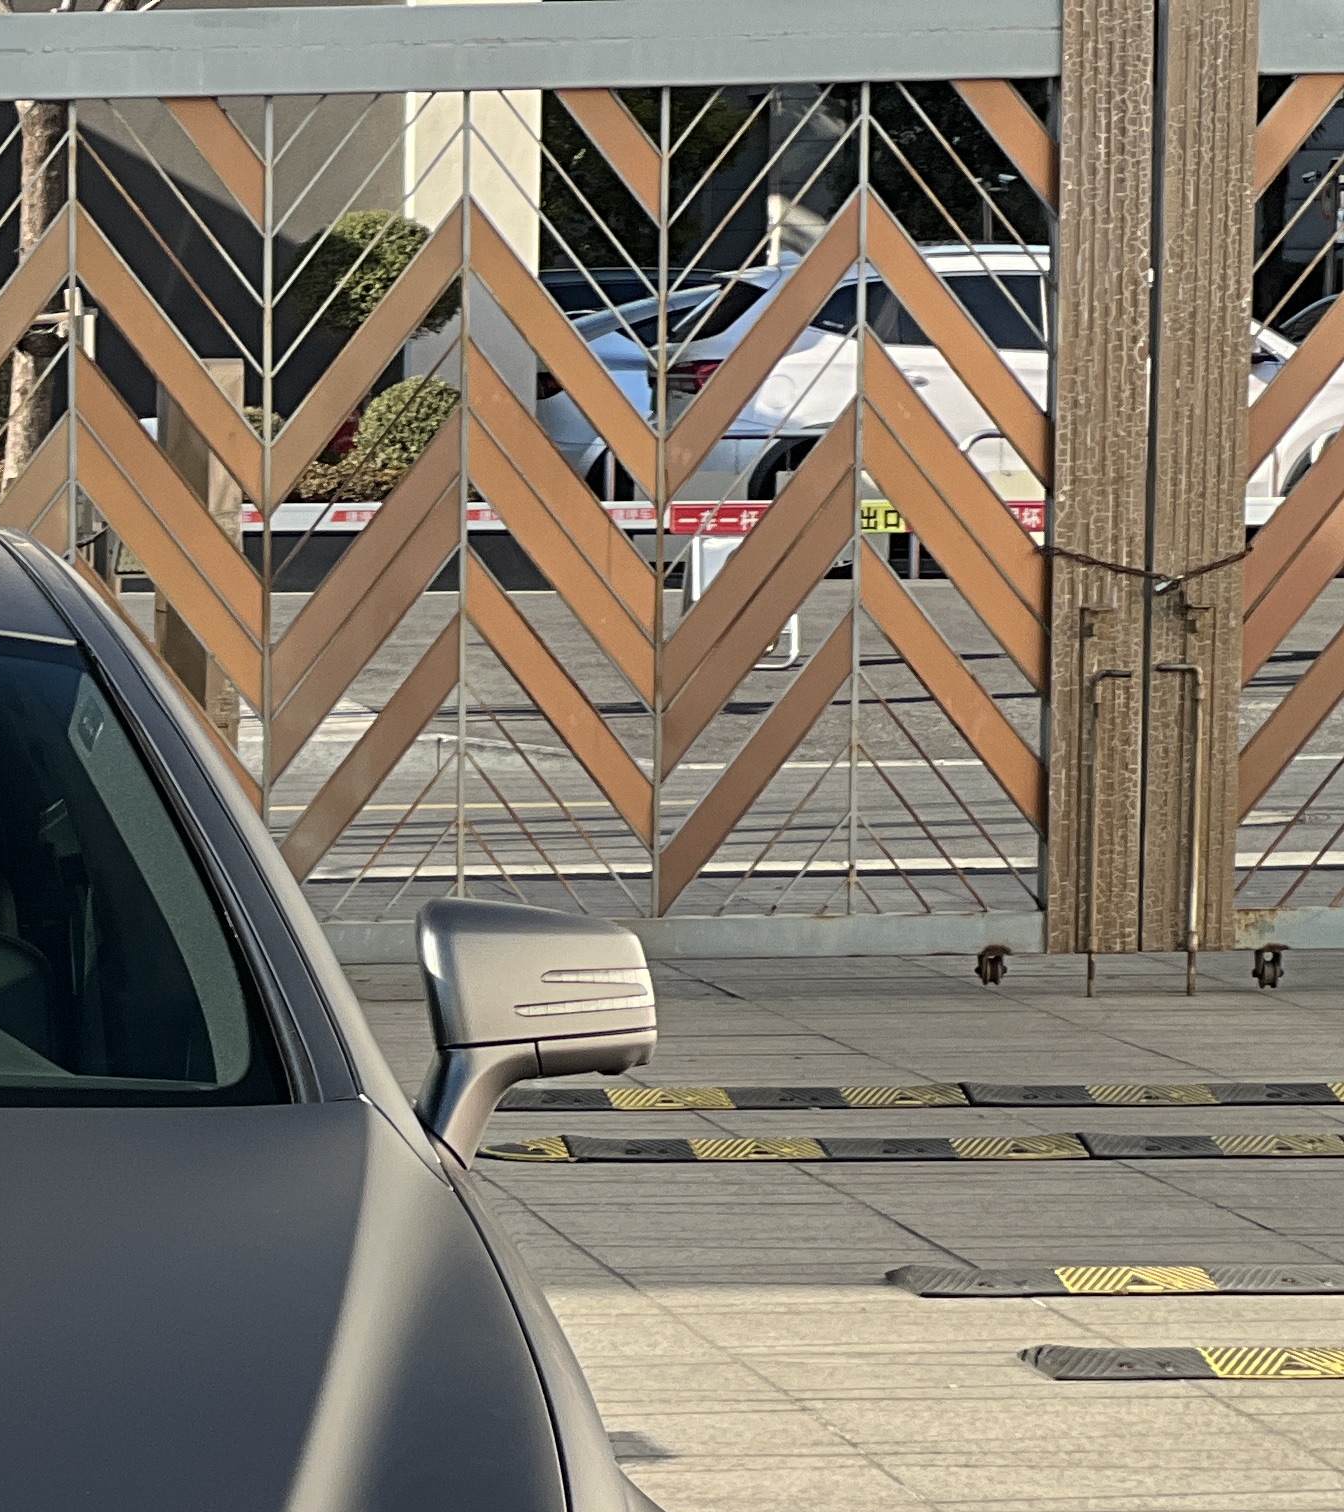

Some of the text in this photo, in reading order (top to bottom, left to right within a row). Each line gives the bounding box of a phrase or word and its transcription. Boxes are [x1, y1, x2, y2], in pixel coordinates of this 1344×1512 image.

[678, 509, 760, 531] 一车一杆
[861, 507, 900, 529] 出口
